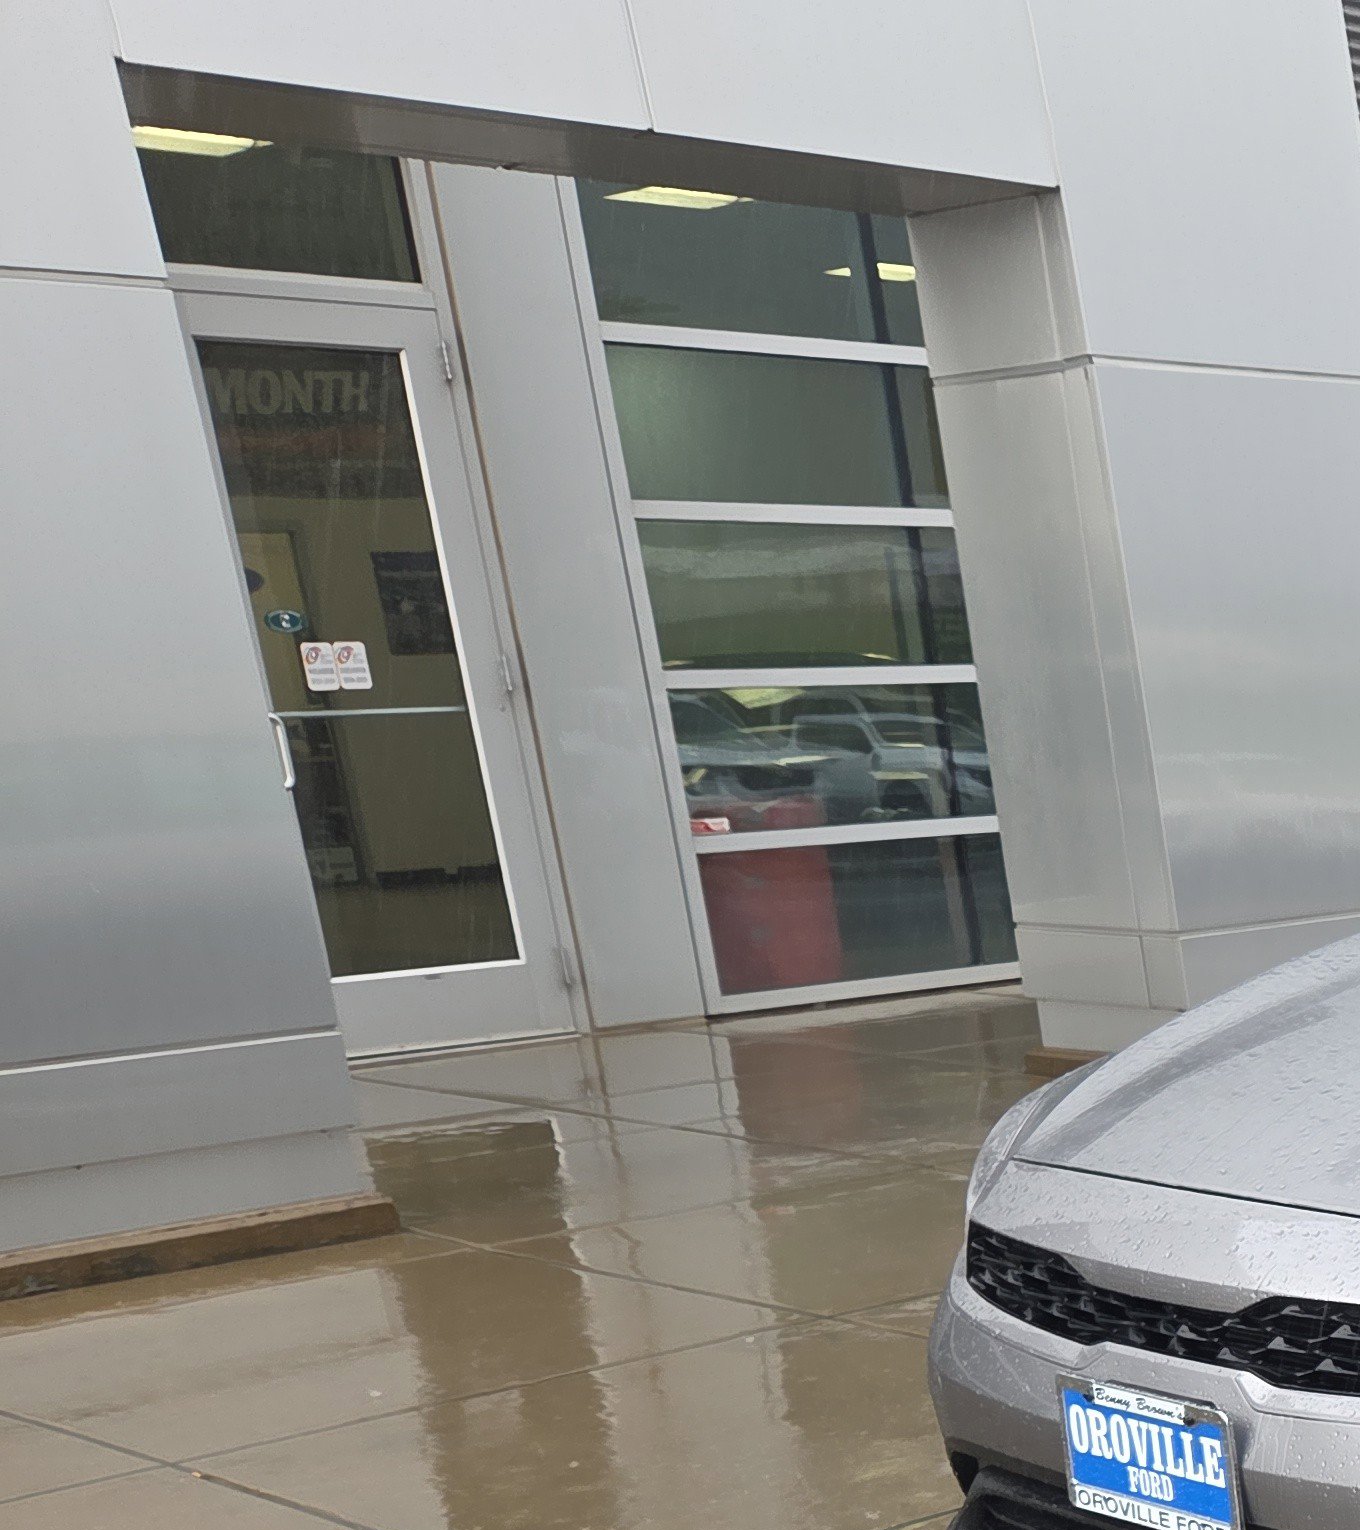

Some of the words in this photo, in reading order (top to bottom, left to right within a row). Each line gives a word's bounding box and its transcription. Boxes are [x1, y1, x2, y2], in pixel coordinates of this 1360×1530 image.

[1094, 1387, 1131, 1410] Benny
[1135, 1397, 1186, 1421] Brown's
[1069, 1403, 1226, 1488] OROVILLE
[1126, 1465, 1174, 1501] FORD
[1077, 1489, 1171, 1527] OROVILLE
